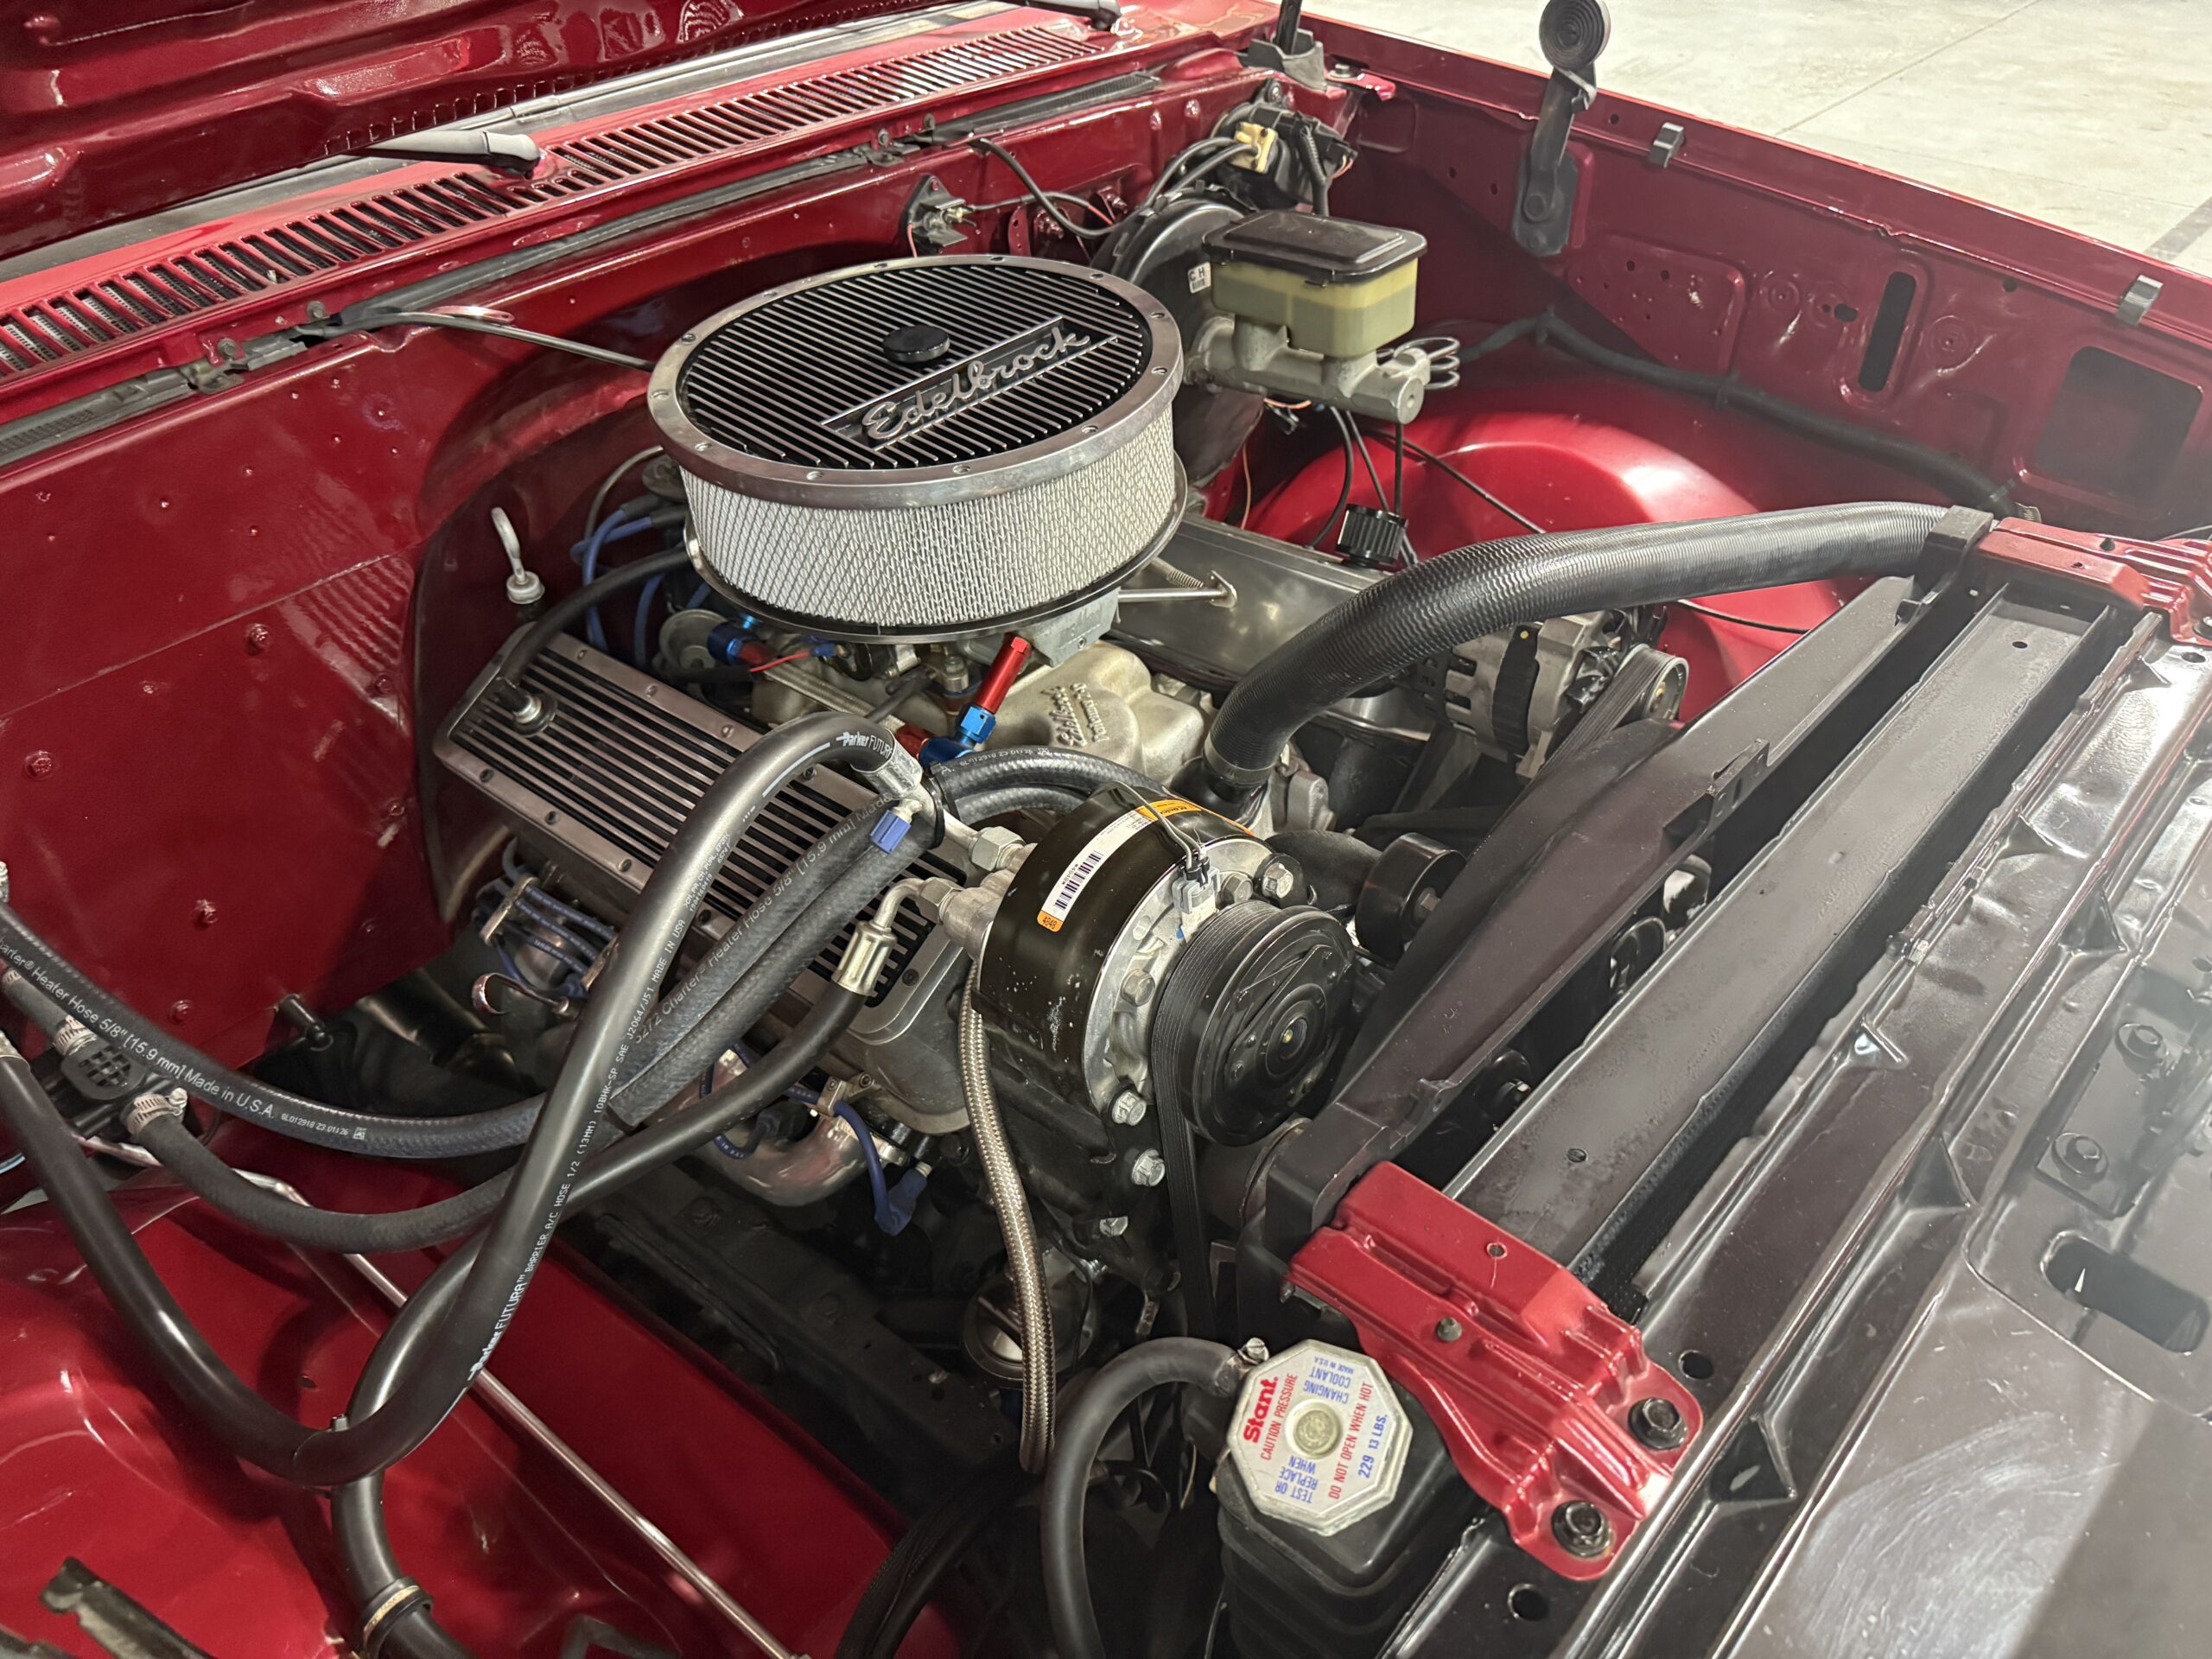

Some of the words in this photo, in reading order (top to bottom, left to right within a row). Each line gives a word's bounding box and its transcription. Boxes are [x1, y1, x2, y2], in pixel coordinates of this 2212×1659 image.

[862, 327, 1090, 440] Edelbrock
[842, 731, 869, 747] Parker
[709, 926, 743, 967] Heater
[743, 897, 772, 928] Hose
[31, 966, 70, 1000] Heater
[68, 995, 99, 1023] Hose
[99, 1019, 128, 1038] 5/8"
[123, 1033, 158, 1060] [15.9
[156, 1057, 188, 1079] mm]
[184, 1068, 219, 1095] Made
[221, 1086, 234, 1102] in
[237, 1093, 274, 1119] U.S.A.
[524, 1233, 549, 1273] BARRIER
[544, 1211, 558, 1230] A/C
[554, 1183, 571, 1207] HOSE
[567, 1160, 581, 1178] 1/2
[576, 1120, 597, 1154] (13MM)
[594, 1067, 619, 1114] 10BHK-SP
[616, 1044, 629, 1064] SAE
[626, 987, 654, 1040] J2064/J51
[651, 957, 668, 982] MADE
[664, 940, 676, 954] IN
[671, 918, 686, 938] USA
[1309, 1367, 1351, 1389] COOLANT
[1338, 1364, 1354, 1375] MADE
[1303, 1380, 1350, 1404] CHANGING
[1361, 1381, 1374, 1402] HOT
[1243, 1379, 1277, 1443] Stant
[1261, 1421, 1282, 1460] CAUTION
[1274, 1373, 1298, 1418] PRESSURE
[1350, 1403, 1367, 1432] WHEN
[1371, 1414, 1388, 1438] LBS.
[1340, 1429, 1357, 1460] OPEN
[1368, 1439, 1380, 1450] 13
[1288, 1455, 1316, 1473] WHEN
[1333, 1458, 1350, 1483] NOT
[1357, 1455, 1375, 1478] 229
[1274, 1480, 1287, 1494] OR
[1279, 1466, 1319, 1490] REPLACE
[1289, 1485, 1313, 1503] TEST
[1328, 1484, 1342, 1499] DO
